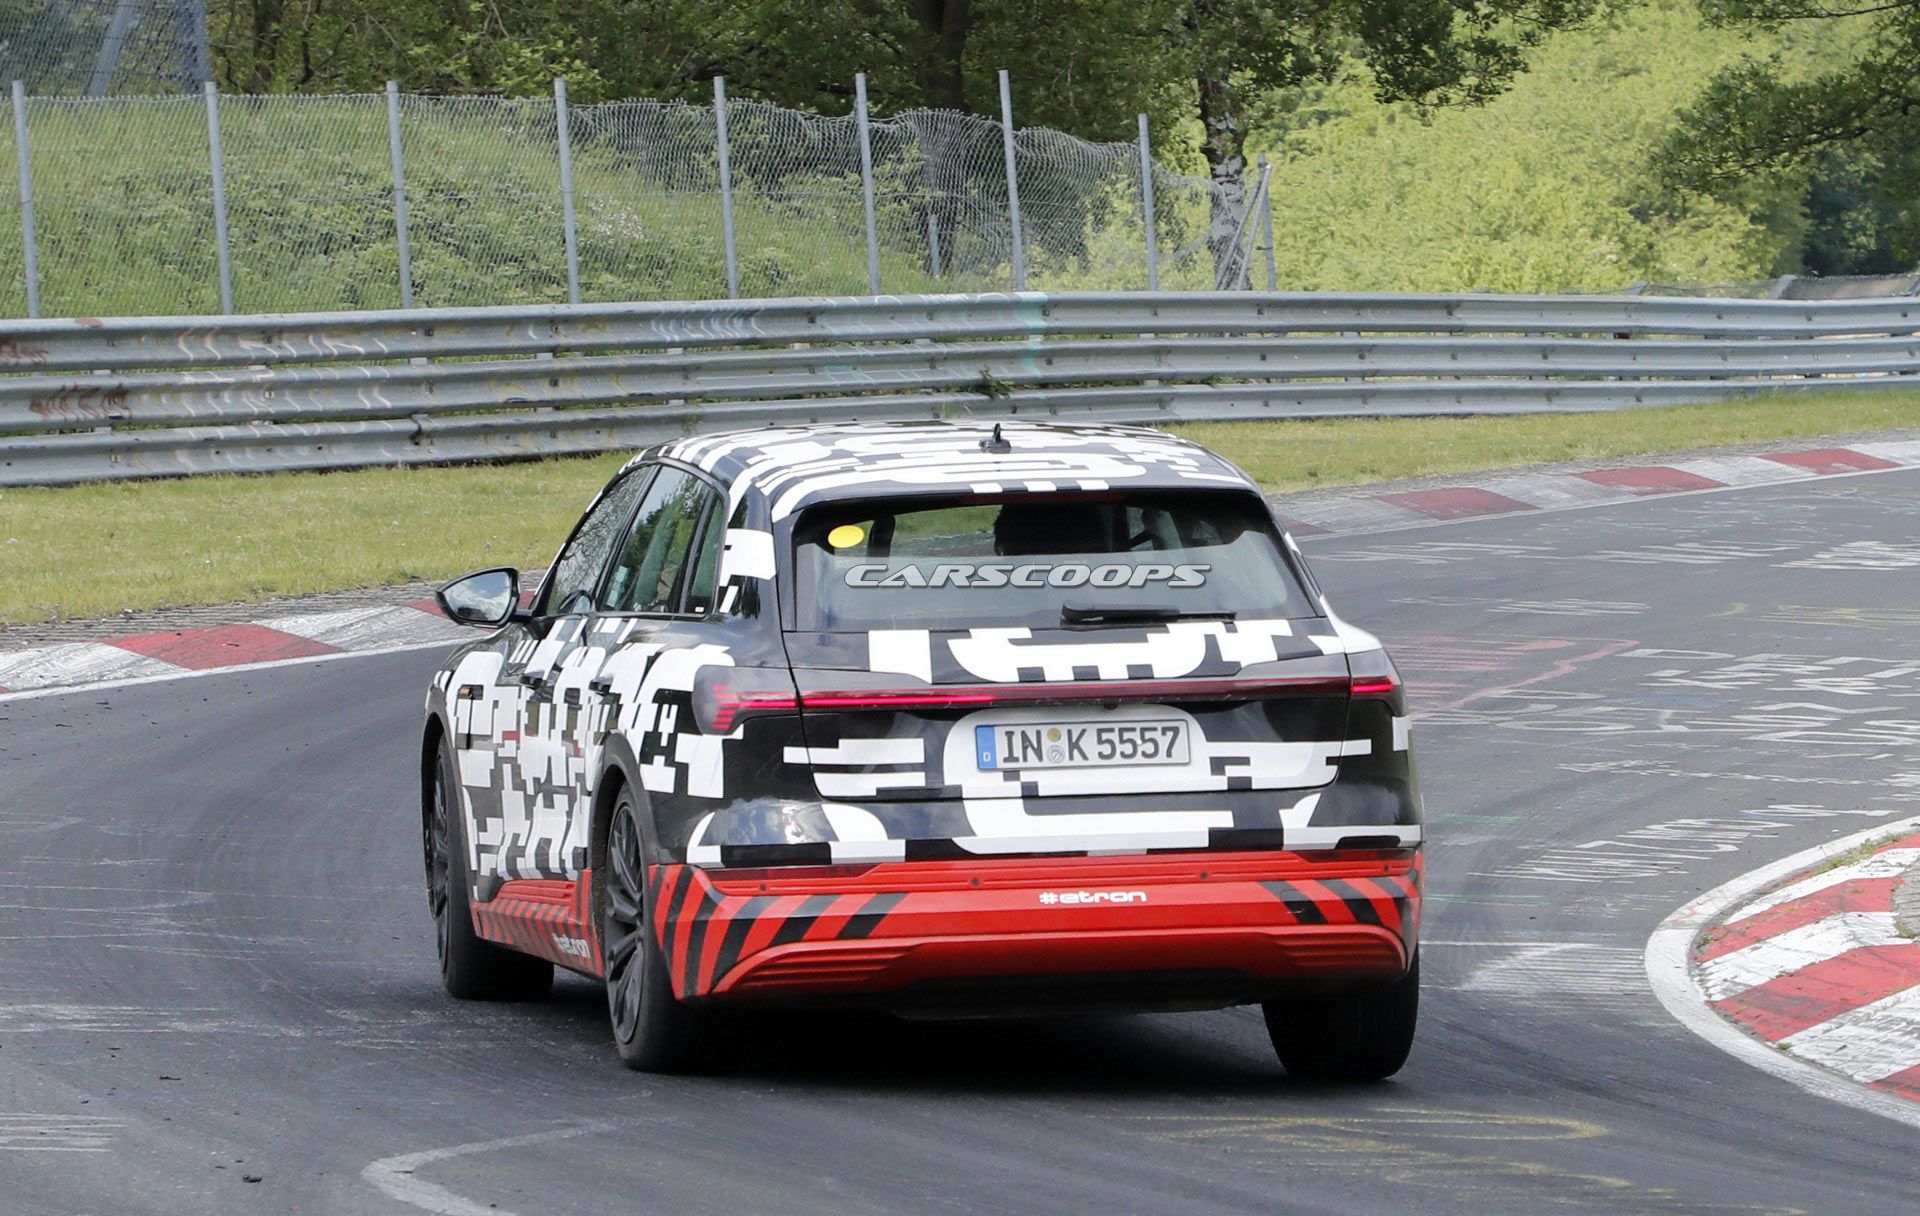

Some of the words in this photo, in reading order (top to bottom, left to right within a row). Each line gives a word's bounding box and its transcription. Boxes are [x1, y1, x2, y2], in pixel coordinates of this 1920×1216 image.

[1003, 729, 1043, 763] IN
[1067, 728, 1090, 761] K
[1096, 726, 1180, 760] 5557
[1039, 891, 1147, 905] #etron
